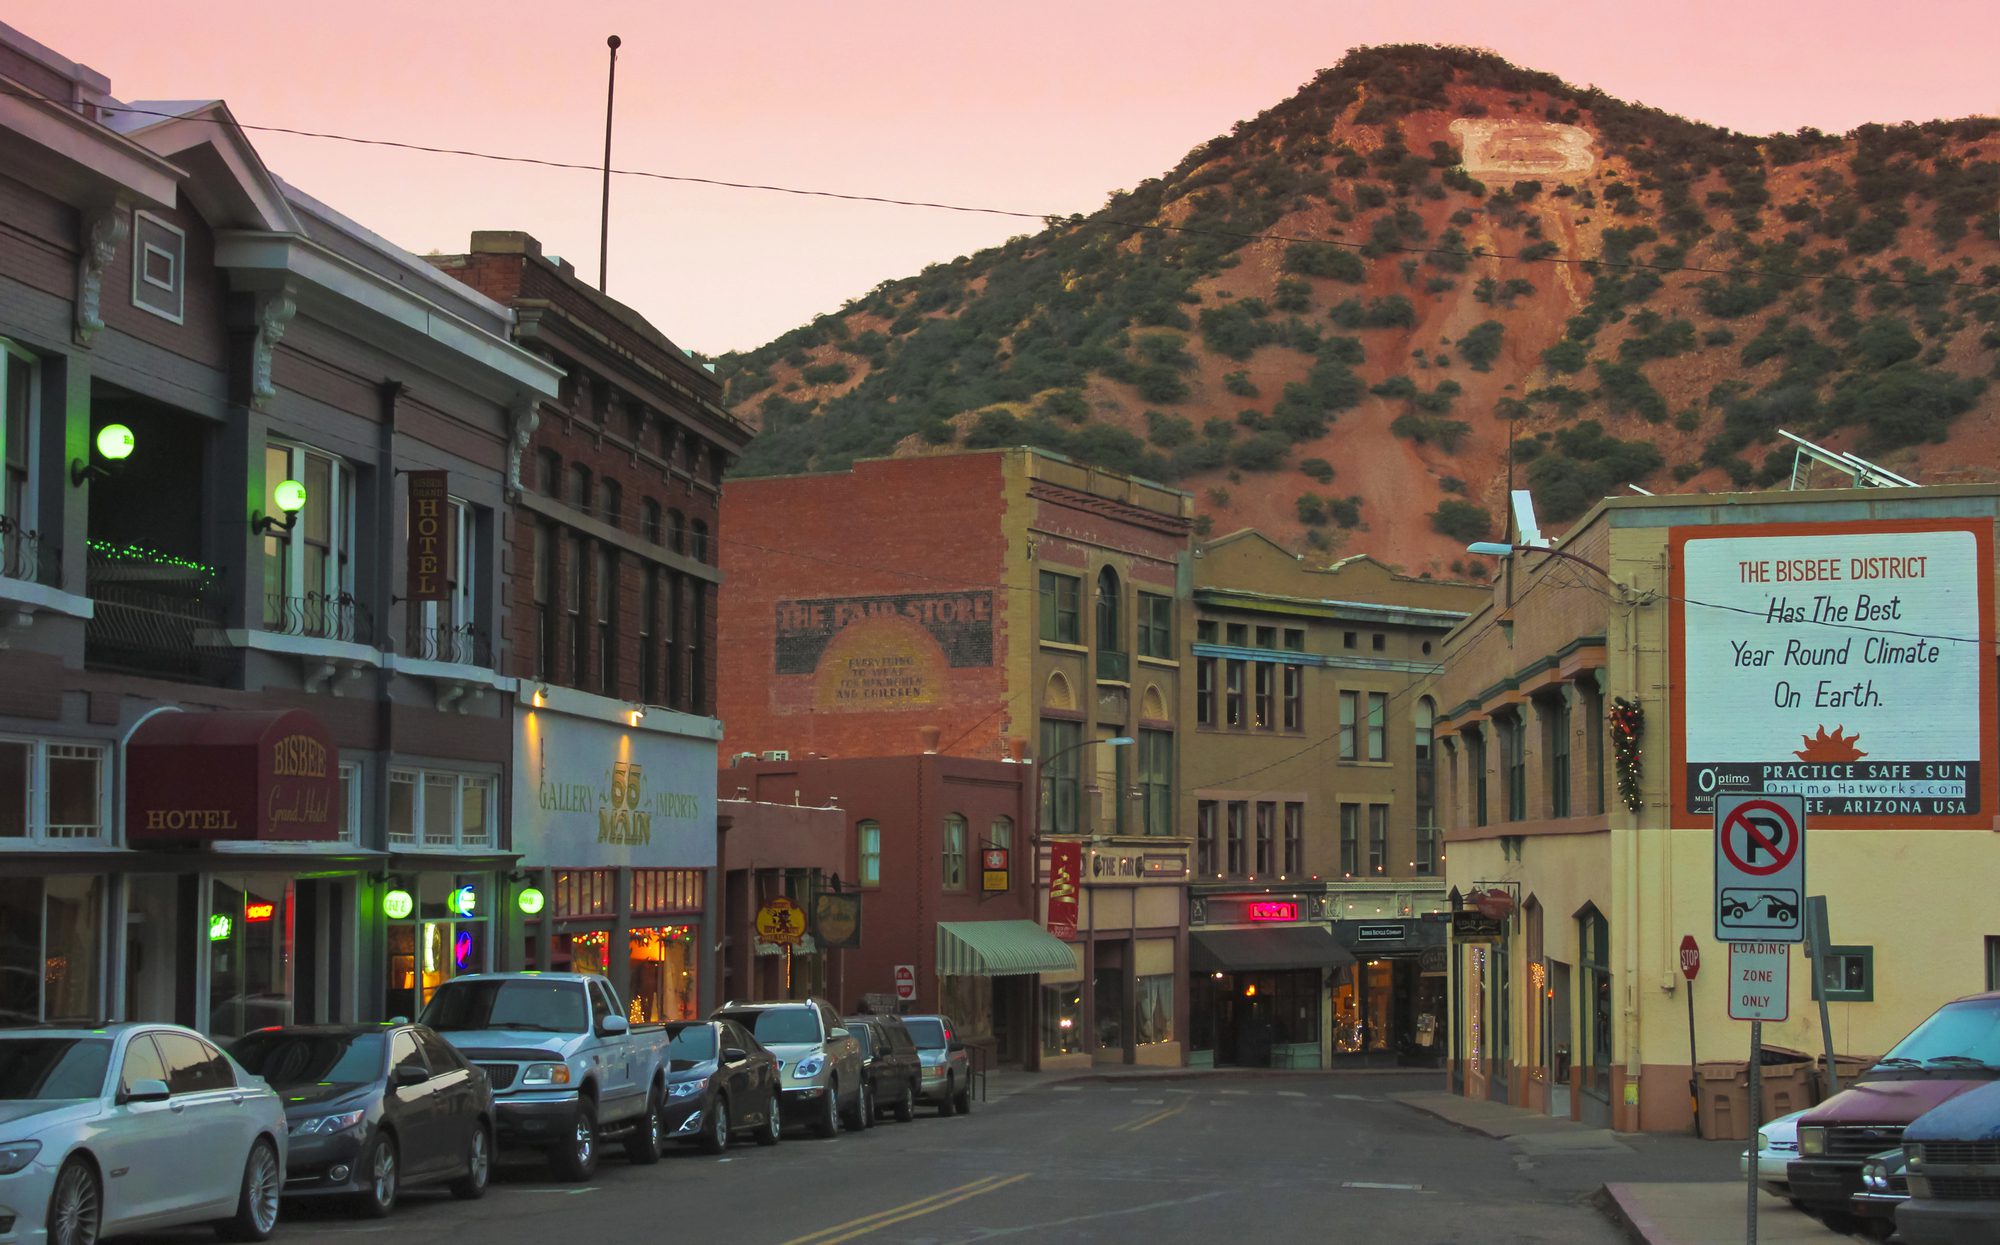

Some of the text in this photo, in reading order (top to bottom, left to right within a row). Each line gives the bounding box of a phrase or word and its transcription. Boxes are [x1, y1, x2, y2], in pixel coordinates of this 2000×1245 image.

[418, 499, 438, 593] HOTEL
[1739, 557, 1927, 583] THE BISBEE DISTRICT
[1766, 594, 1901, 623] Has The Best
[1731, 637, 1940, 667] Year Round Climate
[837, 688, 920, 698] AND CHILDREN
[1774, 680, 1883, 708] On Earth.
[273, 735, 327, 777] BISBEE
[1763, 765, 1966, 779] PRACTICE SAFE SUN
[611, 762, 642, 810] 55
[268, 785, 300, 832] Grand
[540, 782, 698, 818] GALLERY IMPORTS
[1844, 800, 1922, 813] ARIZONA
[1933, 800, 1966, 814] USA
[146, 810, 238, 830] HOTEL
[598, 808, 651, 845] MAIN
[1101, 856, 1134, 876] THE FAIR
[1681, 949, 1698, 966] STOP
[1733, 944, 1785, 955] LOADING
[1743, 970, 1772, 982] ZONE
[1742, 995, 1770, 1007] ONLY
